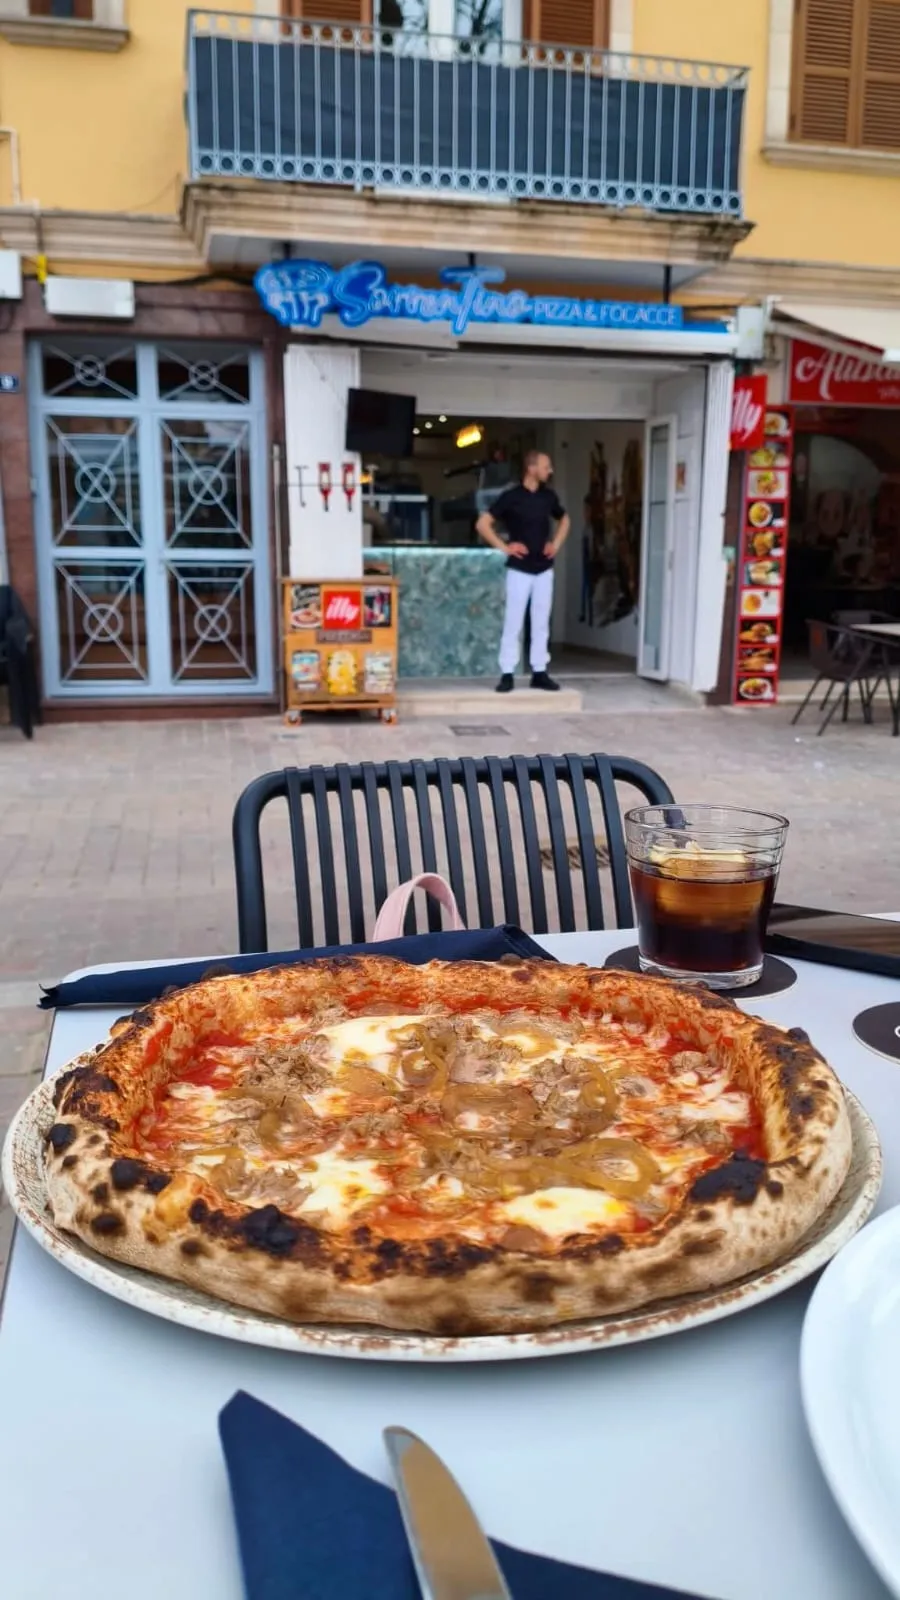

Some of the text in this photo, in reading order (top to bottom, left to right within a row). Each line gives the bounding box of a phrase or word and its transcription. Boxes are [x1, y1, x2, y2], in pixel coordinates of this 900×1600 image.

[534, 300, 582, 321] PIZZA
[584, 302, 597, 321] &
[600, 303, 676, 325] FOCACCE
[731, 388, 762, 441] lly
[326, 596, 360, 624] illy
